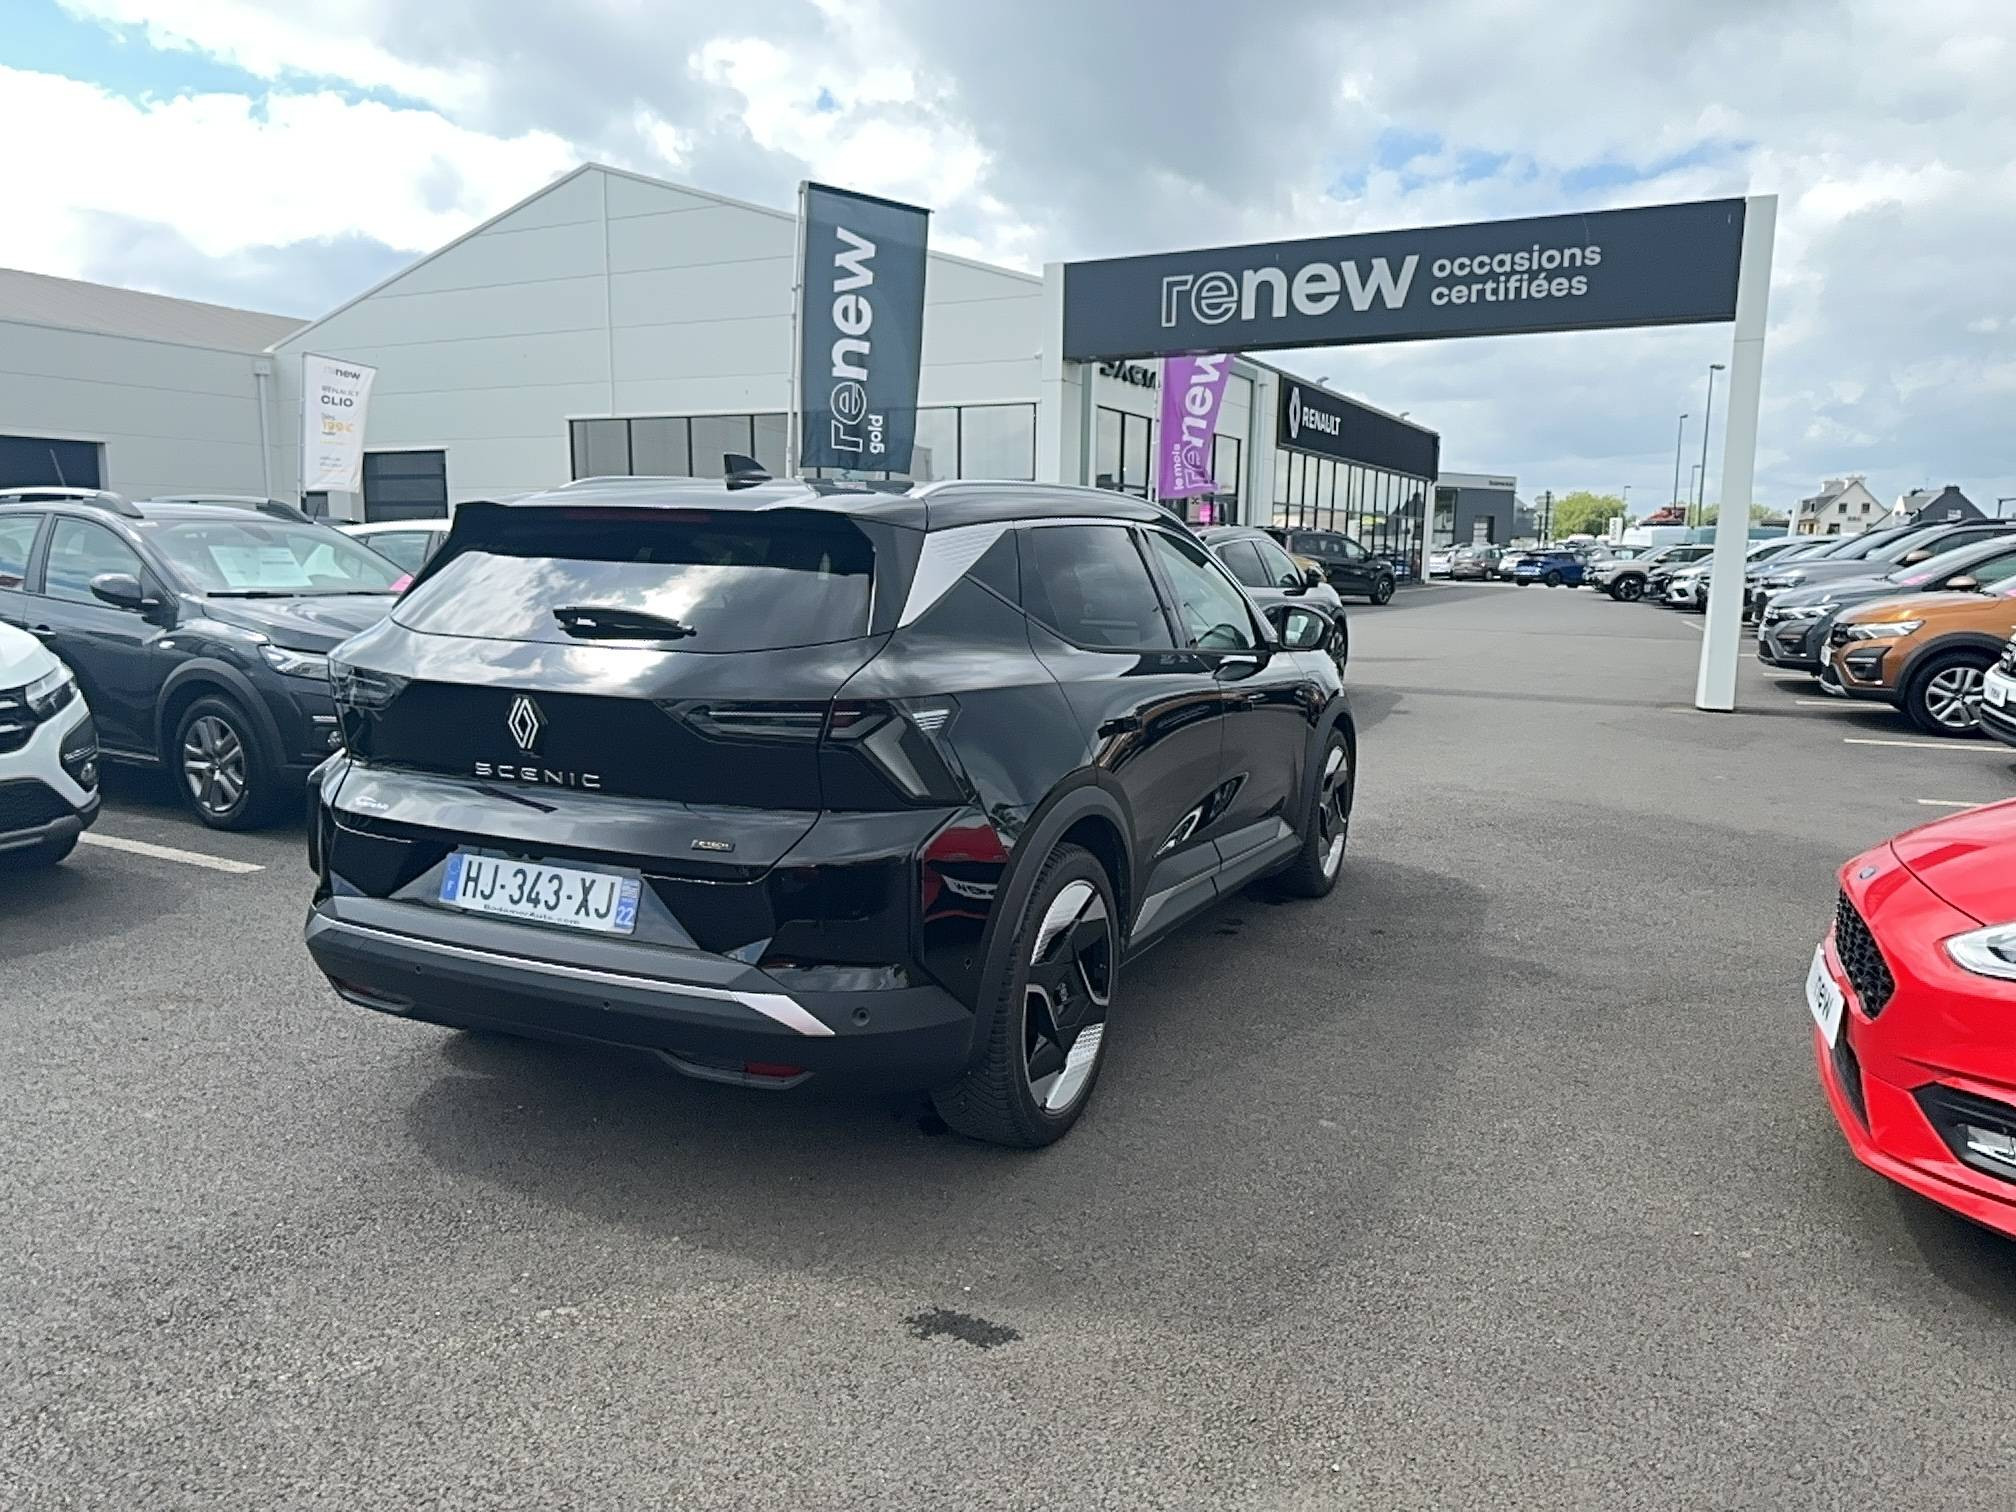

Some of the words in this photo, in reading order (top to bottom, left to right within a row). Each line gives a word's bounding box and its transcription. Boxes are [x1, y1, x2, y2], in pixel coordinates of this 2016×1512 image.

[1432, 244, 1602, 278] occasions
[1161, 254, 1420, 327] renew
[1430, 271, 1588, 306] certifiées
[831, 226, 876, 452] renew
[320, 394, 353, 407] CLIO
[868, 415, 885, 455] gold
[1302, 406, 1341, 436] RENAULT
[1171, 443, 1183, 476] mois
[475, 762, 601, 789] SCENIC
[462, 860, 616, 919] HJ-343-XJ
[615, 905, 635, 925] 22
